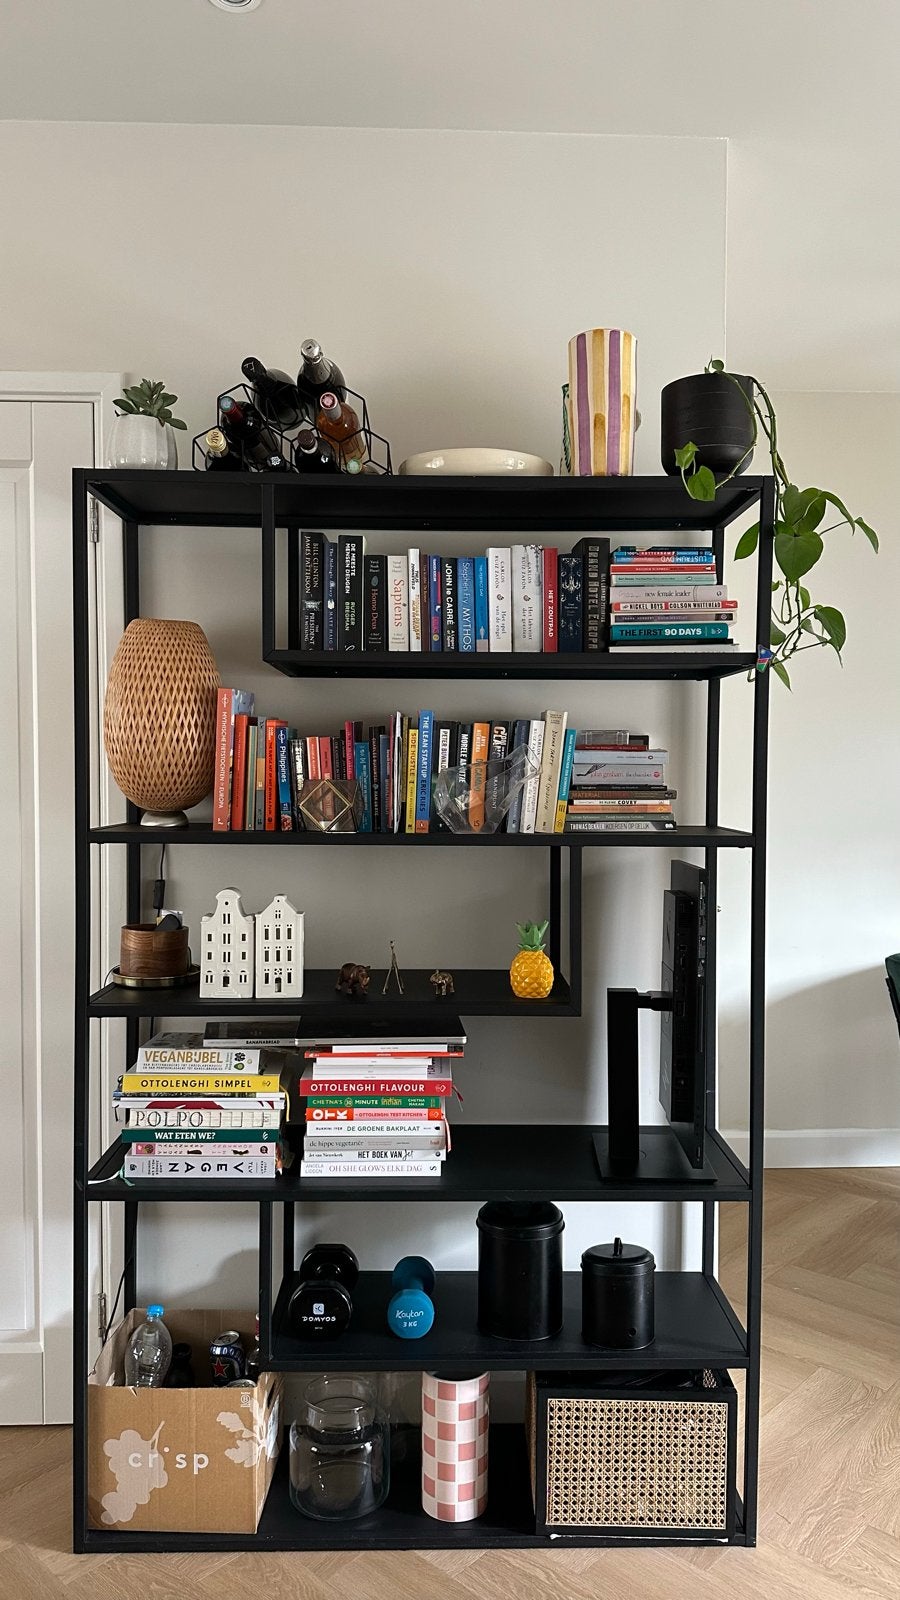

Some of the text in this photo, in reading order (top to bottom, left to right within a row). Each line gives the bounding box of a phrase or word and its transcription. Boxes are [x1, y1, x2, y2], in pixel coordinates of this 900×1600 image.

[350, 543, 356, 552] DE
[446, 588, 452, 596] le
[588, 546, 599, 649] GRAND HOTEL EUROPA
[391, 579, 404, 628] Sapiens
[461, 562, 471, 650] Stephen Fry MYTHOS
[460, 734, 469, 758] MORELE
[144, 1050, 223, 1063] VEGANBIJBEL
[141, 1079, 251, 1088] OTTOLENGHI SIMPEL
[310, 1083, 424, 1092] OTTOLENGHI FLAVOUR
[135, 1111, 204, 1127] POLPO
[312, 1110, 348, 1120] OTK
[168, 1162, 244, 1173] VEGAN
[396, 1310, 424, 1319] Kaytan
